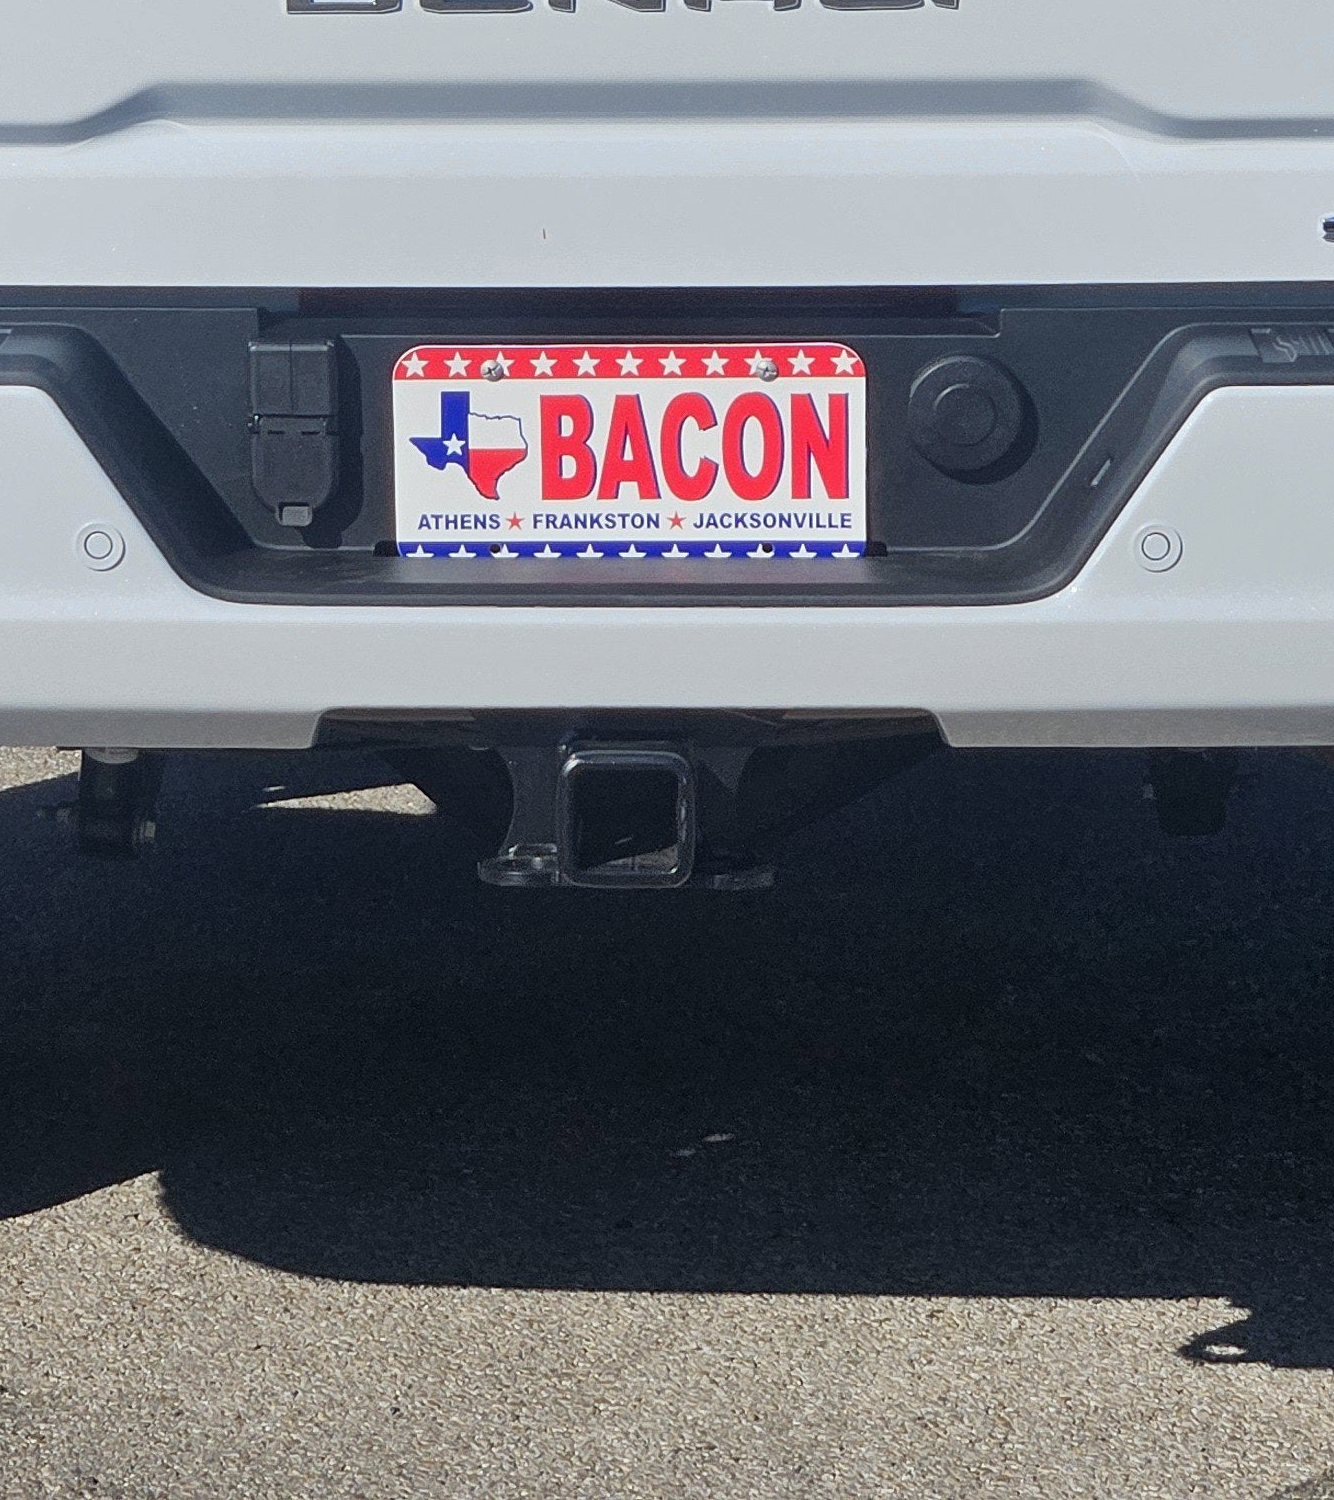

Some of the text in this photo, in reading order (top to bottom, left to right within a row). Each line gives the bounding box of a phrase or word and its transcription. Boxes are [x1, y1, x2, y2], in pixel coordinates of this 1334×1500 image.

[539, 391, 850, 501] BACON
[417, 512, 852, 530] ATHENS FRANKSTON JACKSONVILLE
